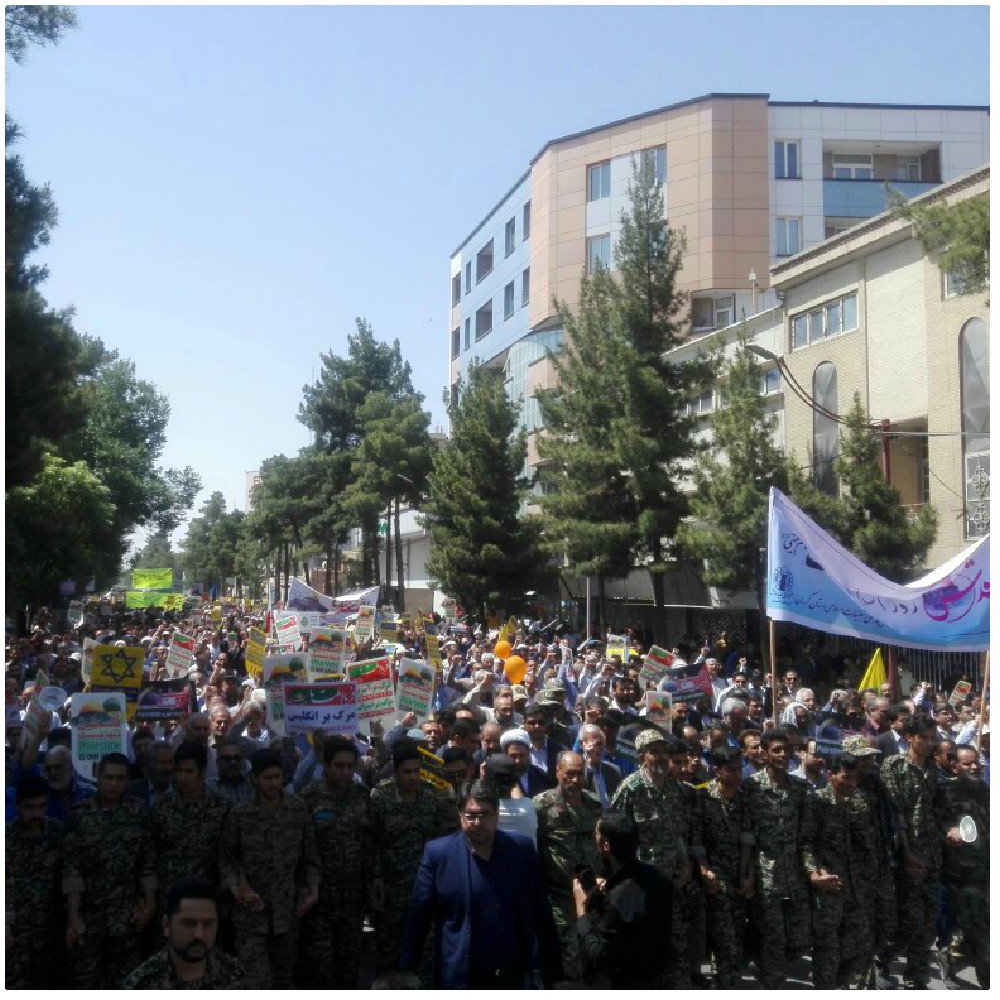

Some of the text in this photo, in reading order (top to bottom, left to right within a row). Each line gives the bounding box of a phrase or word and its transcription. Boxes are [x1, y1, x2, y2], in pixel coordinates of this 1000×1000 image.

[288, 710, 318, 722] انگلیس
[321, 713, 330, 724] بر
[332, 710, 356, 722] مرگ
